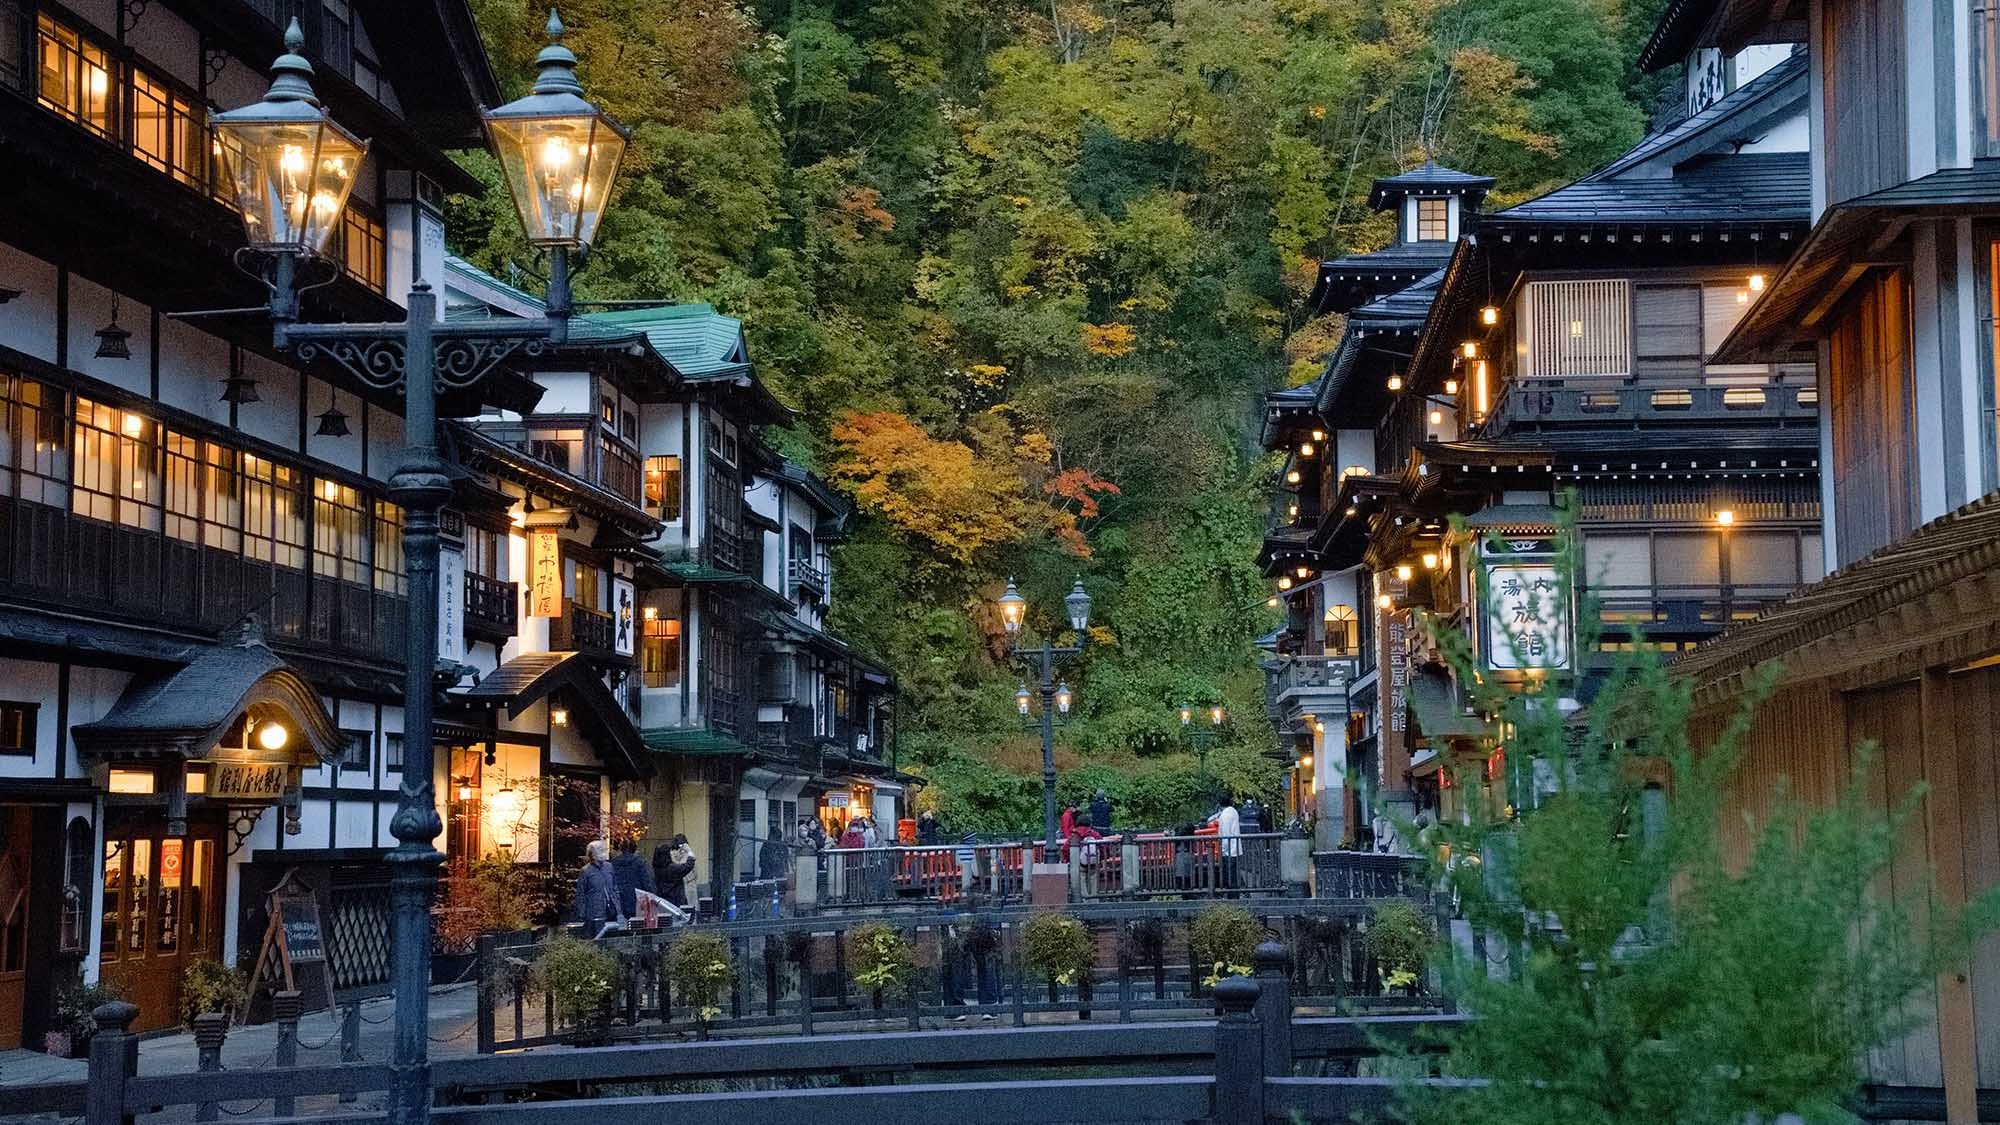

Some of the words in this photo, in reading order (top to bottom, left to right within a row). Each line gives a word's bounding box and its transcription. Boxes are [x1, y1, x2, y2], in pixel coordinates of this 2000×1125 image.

[1389, 623, 1407, 733] 能登屋旅館
